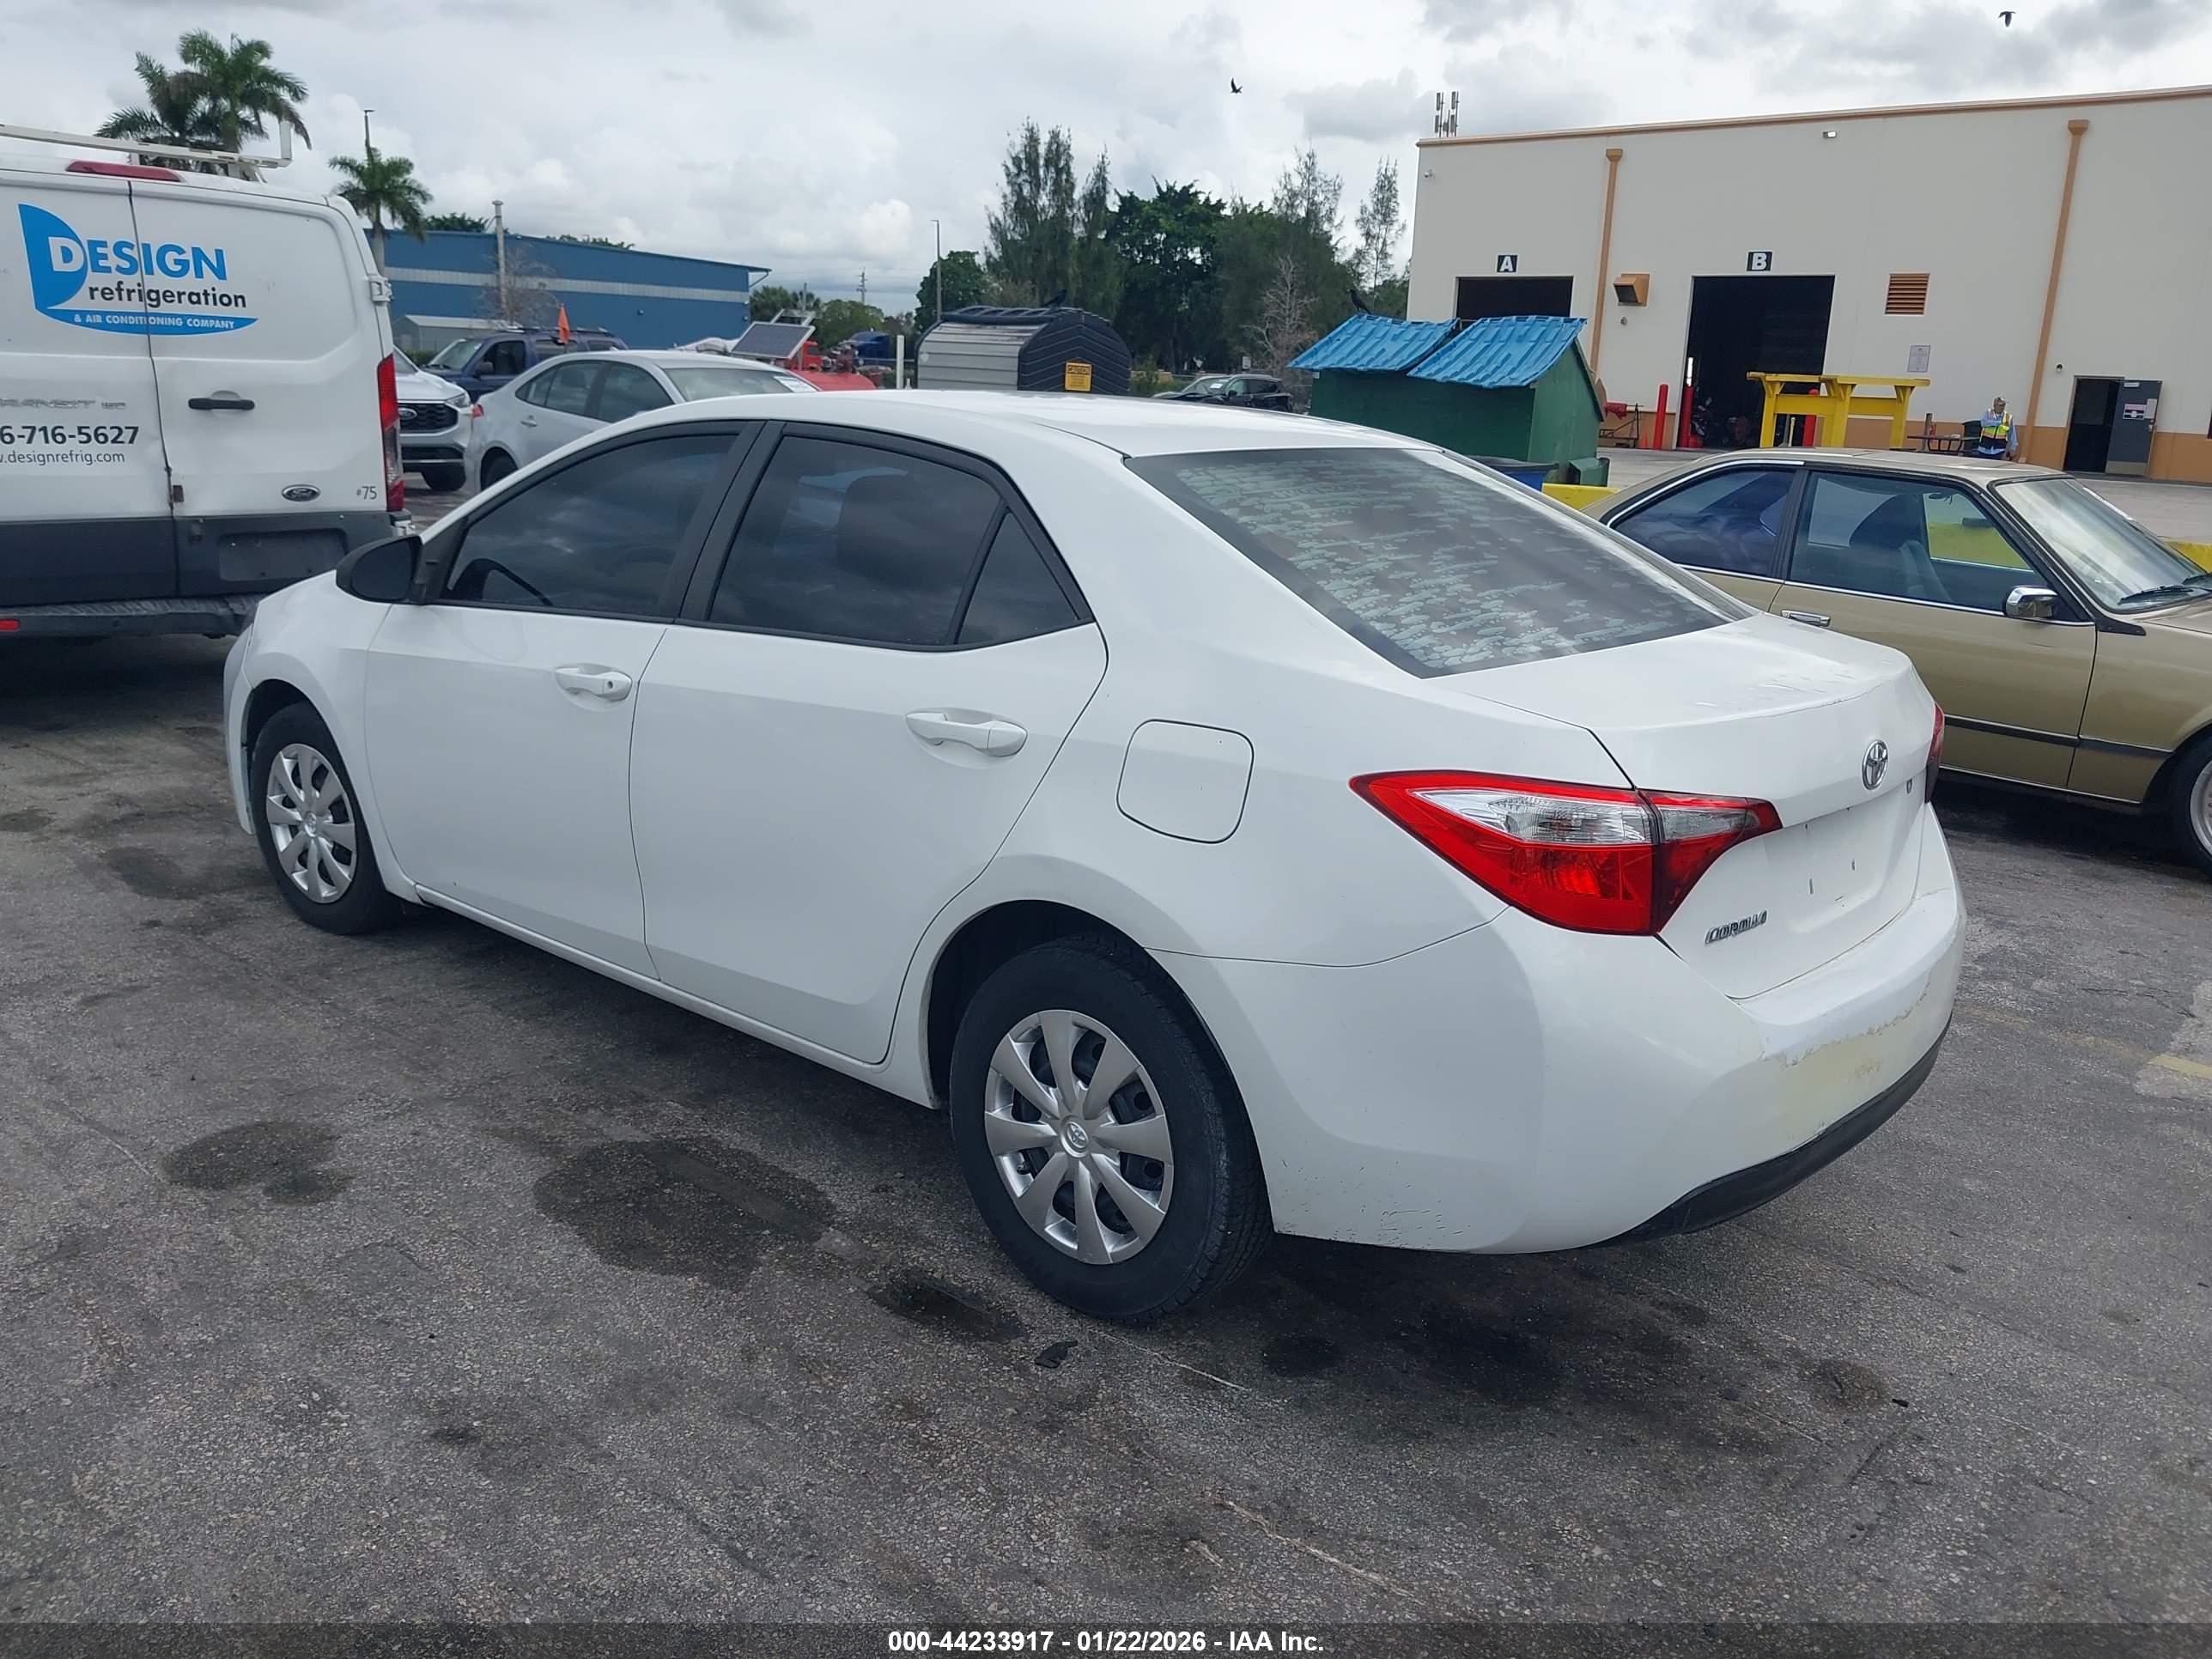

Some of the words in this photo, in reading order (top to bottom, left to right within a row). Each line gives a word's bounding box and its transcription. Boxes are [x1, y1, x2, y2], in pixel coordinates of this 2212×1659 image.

[48, 236, 227, 280] DESIGN
[1499, 256, 1514, 272] A
[1752, 252, 1767, 270] B
[88, 280, 246, 308] refrigeration
[74, 314, 82, 323] &
[86, 314, 102, 324] AIR
[106, 315, 183, 327] CONDITIONING
[186, 319, 234, 329] COMPANY
[0, 425, 139, 444] 6-716-5627
[356, 486, 378, 500] #75
